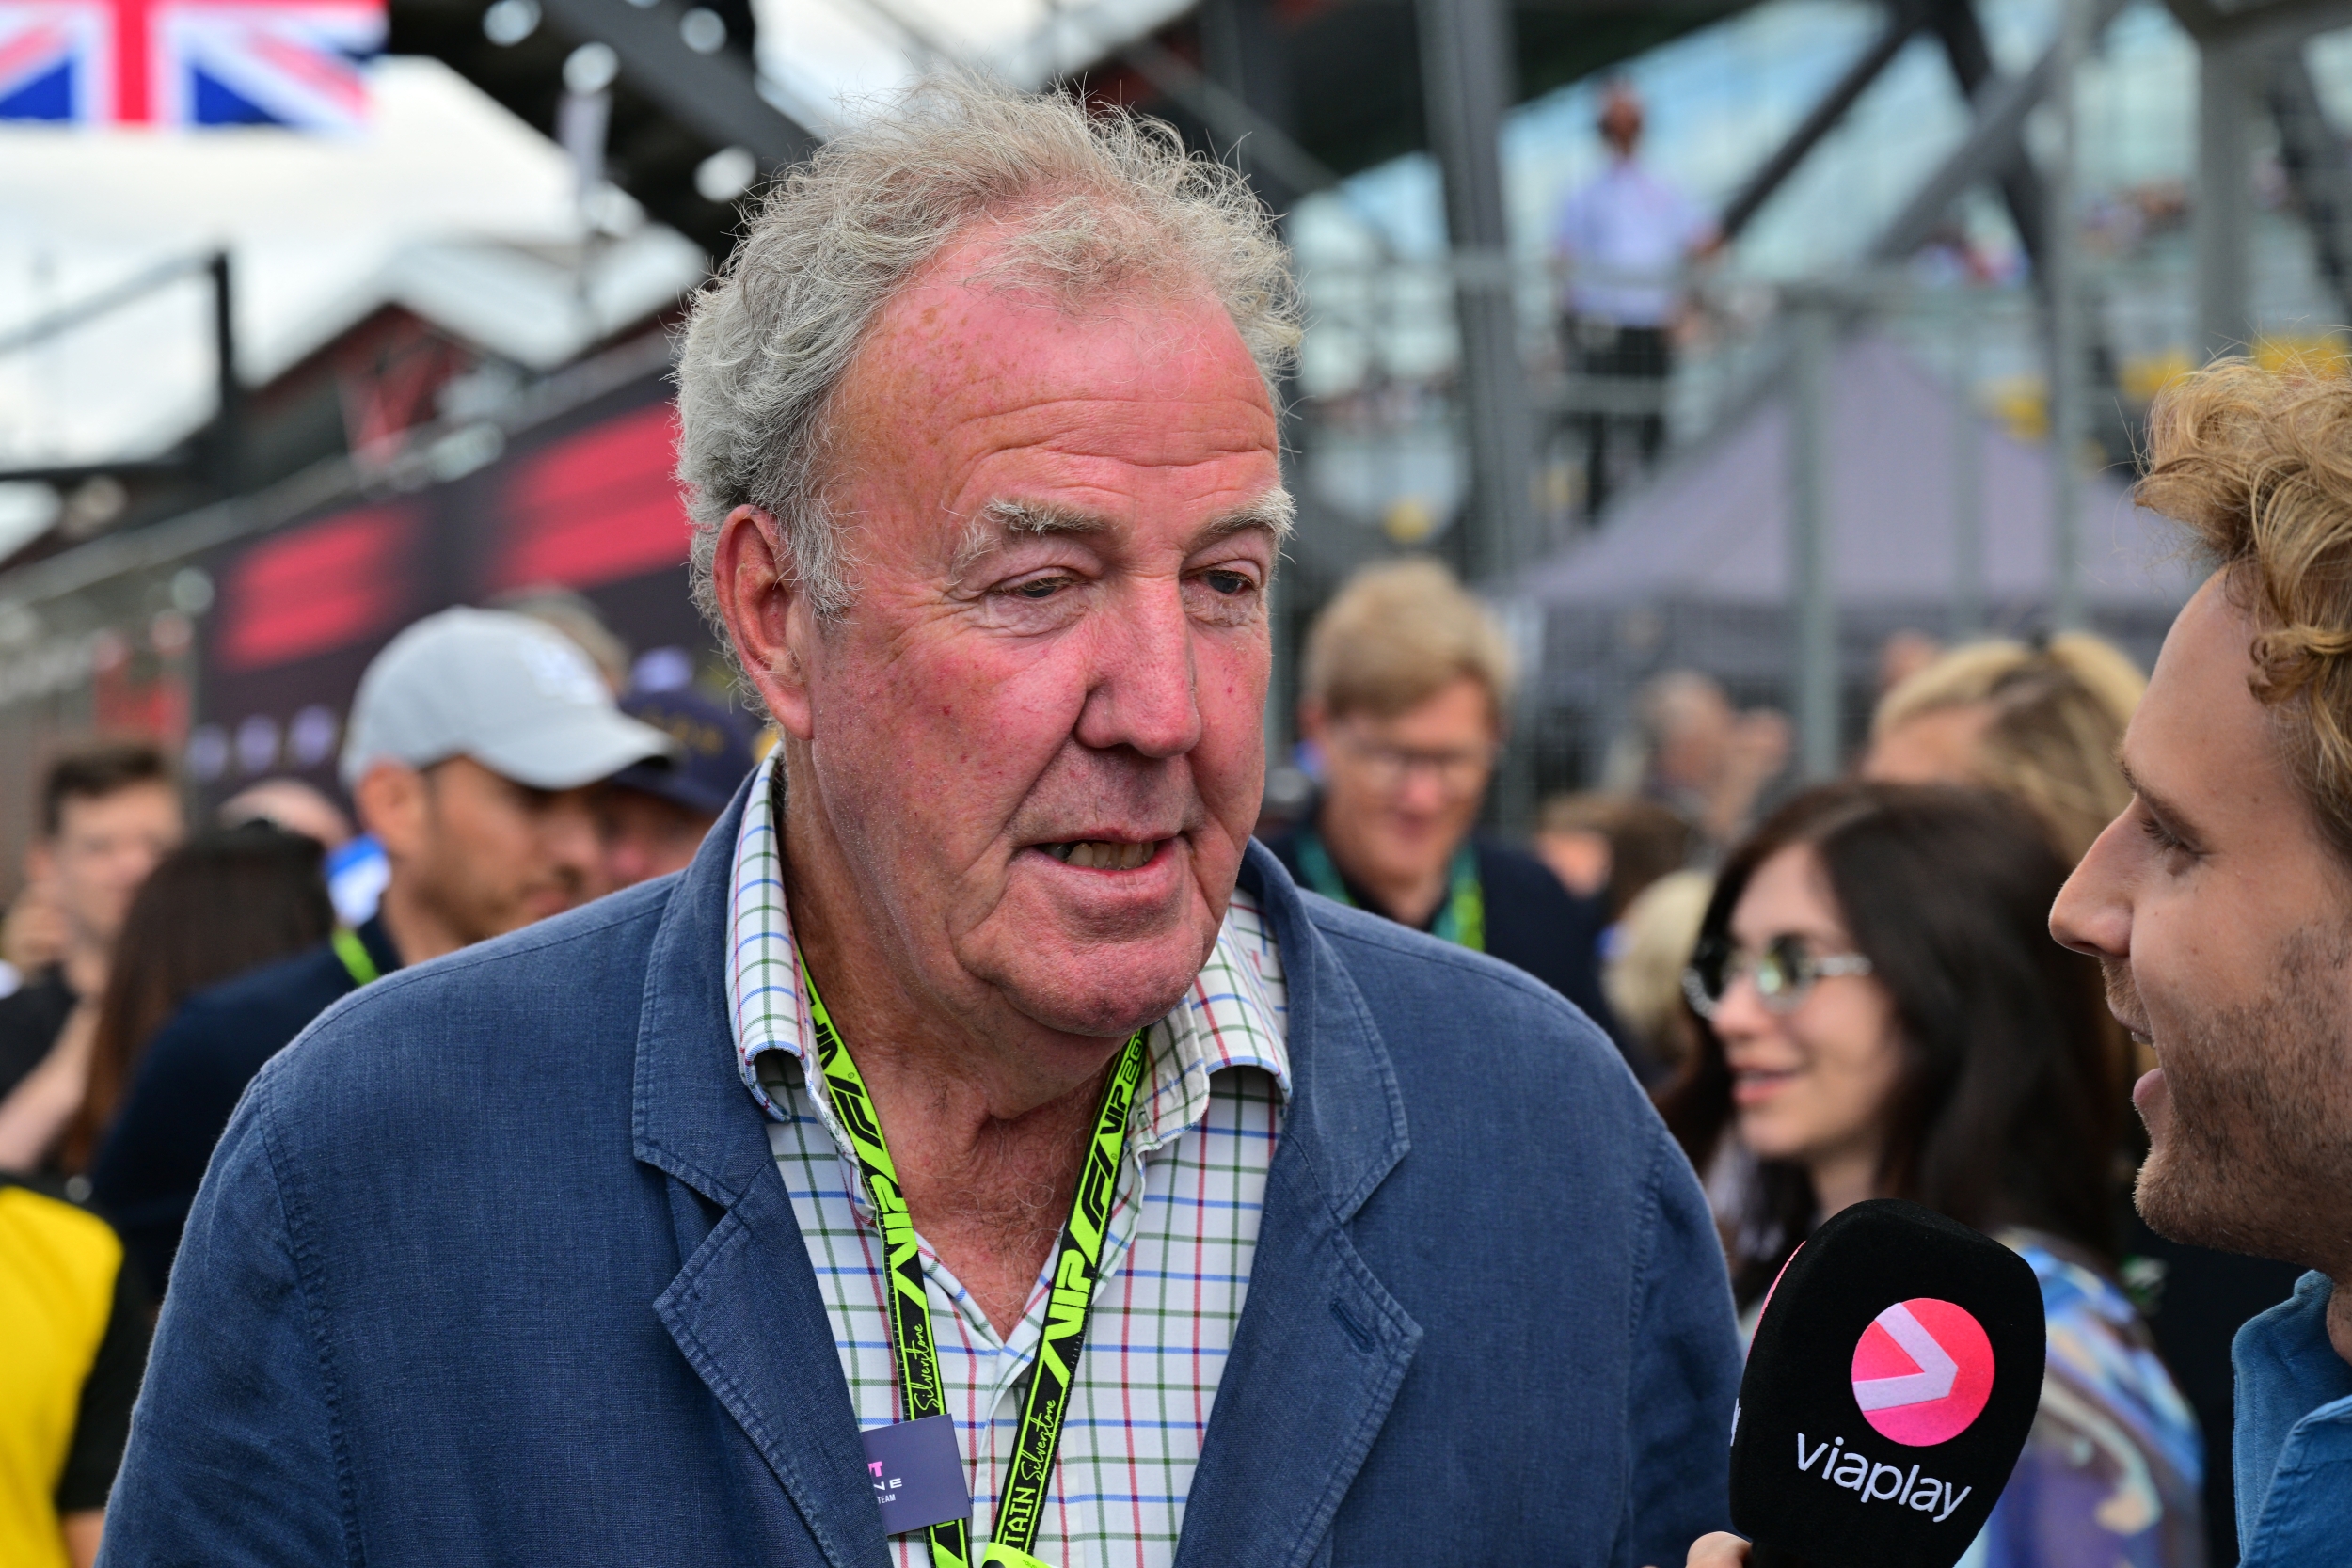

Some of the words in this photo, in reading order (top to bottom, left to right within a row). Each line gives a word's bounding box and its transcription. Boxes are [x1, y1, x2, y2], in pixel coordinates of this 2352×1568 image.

[1099, 1084, 1127, 1135] VIP
[869, 1174, 919, 1270] VIP
[1044, 1249, 1092, 1341] VIP
[904, 1323, 940, 1410] Silverstone
[877, 1494, 896, 1504] TEAM
[1003, 1487, 1036, 1552] TAIN
[1021, 1400, 1056, 1481] Silverstone
[1797, 1433, 1972, 1523] viaplay
